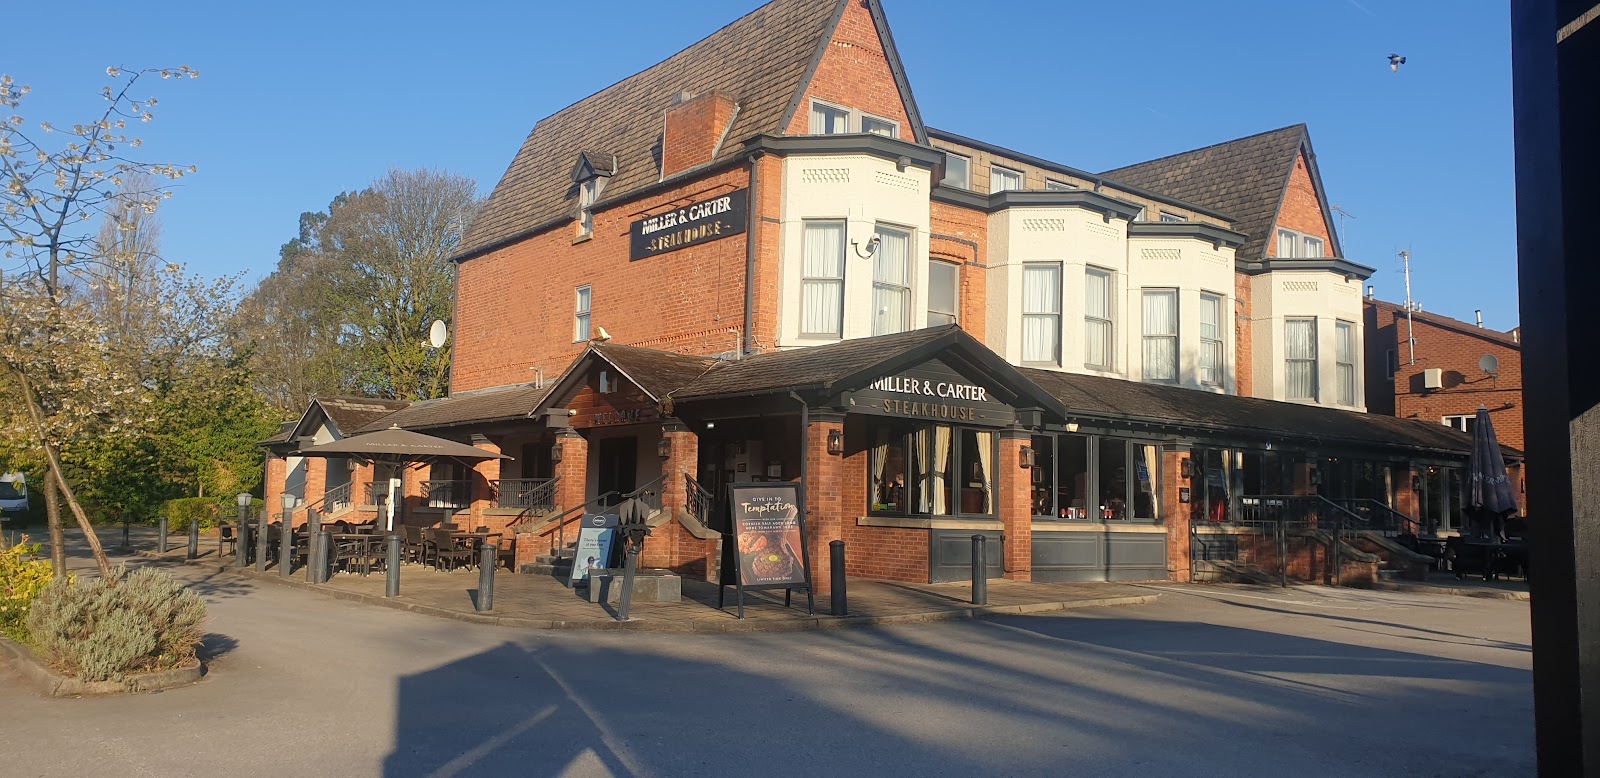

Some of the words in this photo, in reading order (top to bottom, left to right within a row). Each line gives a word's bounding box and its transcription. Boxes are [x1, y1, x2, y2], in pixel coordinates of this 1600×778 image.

[642, 212, 678, 235] MILLER
[679, 209, 688, 224] &
[689, 196, 732, 221] CARTER
[650, 220, 721, 252] STEAKHOUSE
[869, 376, 920, 395] MILLER
[923, 380, 935, 396] &
[937, 382, 987, 402] CARTER
[594, 408, 640, 425] WELCOME
[883, 399, 975, 421] STEAKHOUSE
[741, 502, 795, 517] Temptation
